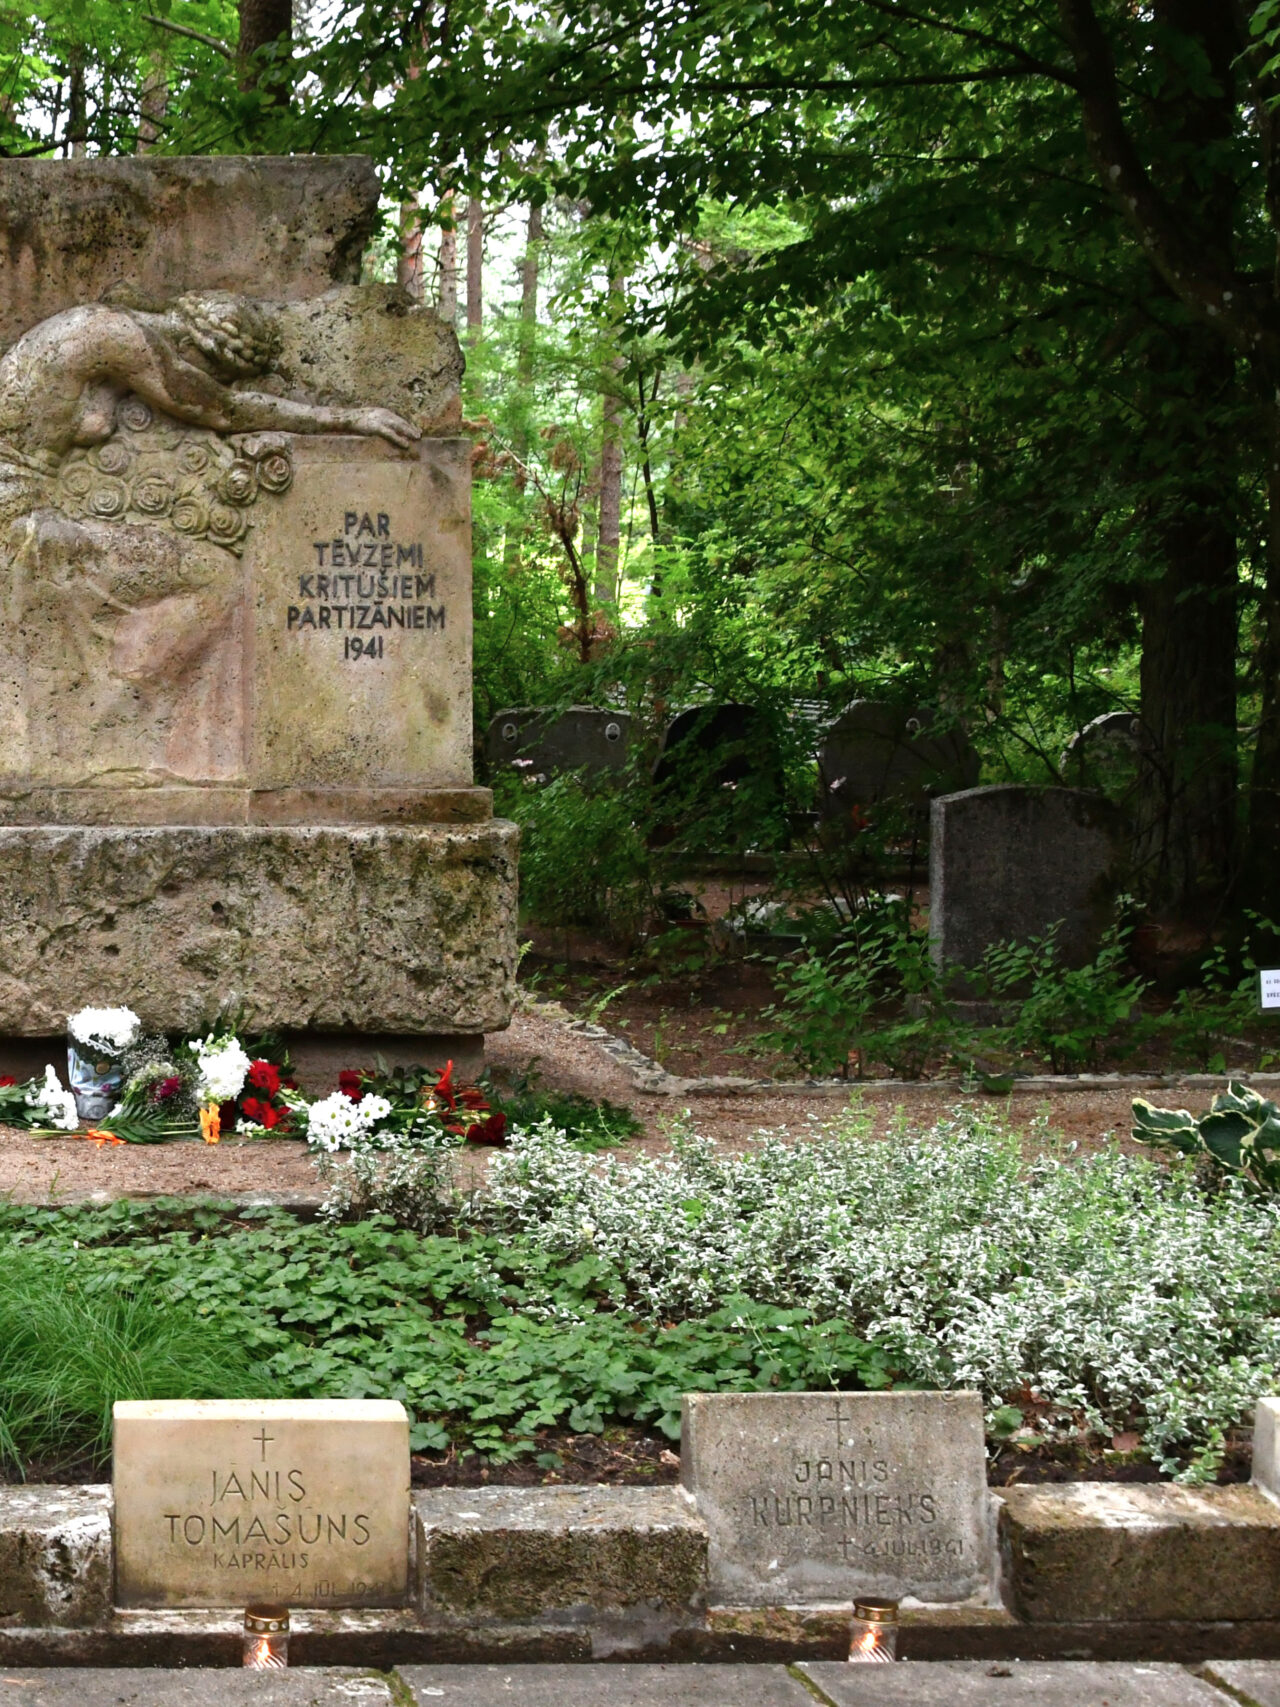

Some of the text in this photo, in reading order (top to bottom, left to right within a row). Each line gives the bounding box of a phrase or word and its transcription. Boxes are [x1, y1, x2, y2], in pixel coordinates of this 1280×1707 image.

[344, 512, 390, 538] PAR
[313, 539, 424, 568] TĒVZEMI
[299, 569, 436, 599] KRITUŠIEM
[287, 601, 446, 630] PARTIZĀNIEM
[344, 636, 384, 661] 1941
[794, 1456, 889, 1483] JĀNIS
[210, 1462, 306, 1507] JĀNIS
[214, 1549, 309, 1569] KAPRĀLIS
